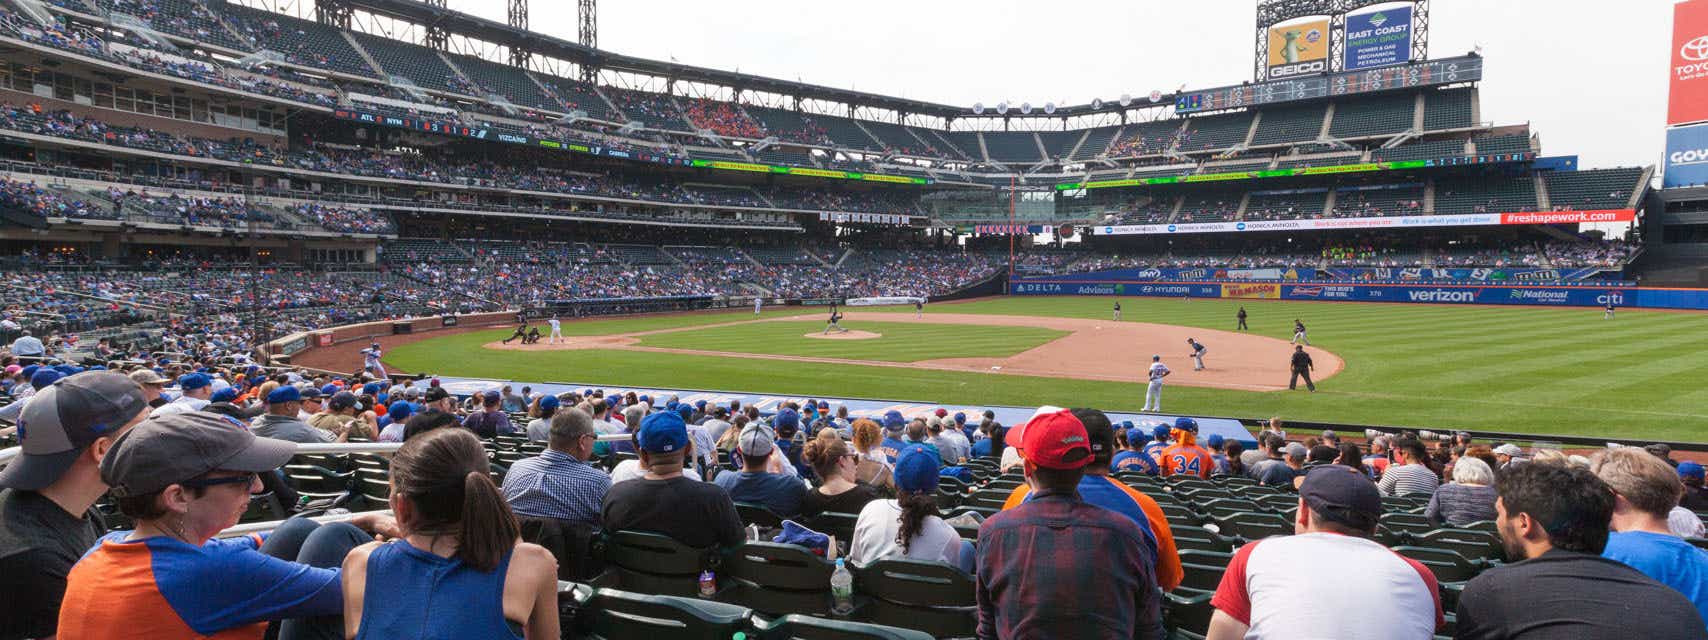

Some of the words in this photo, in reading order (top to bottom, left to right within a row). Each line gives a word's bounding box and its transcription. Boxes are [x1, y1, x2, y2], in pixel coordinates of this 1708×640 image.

[1348, 30, 1371, 40] EAST
[1375, 24, 1408, 36] COAST
[1349, 38, 1377, 47] ENERGY
[1379, 33, 1407, 43] GROUP
[1357, 51, 1396, 60] MECHANICAL
[1357, 57, 1396, 66] PETROLEUM
[1270, 62, 1323, 77] GEICO
[361, 113, 375, 122] ATL
[387, 117, 403, 126] NYM
[1507, 211, 1616, 222] #reshapework.com
[1027, 284, 1062, 292] DELTA
[1078, 286, 1114, 295] Advisors
[1154, 286, 1190, 294] HYUNDAI
[1408, 289, 1475, 302] verizon
[1523, 290, 1568, 300] National
[1596, 292, 1623, 304] citi
[1173, 454, 1201, 476] 34
